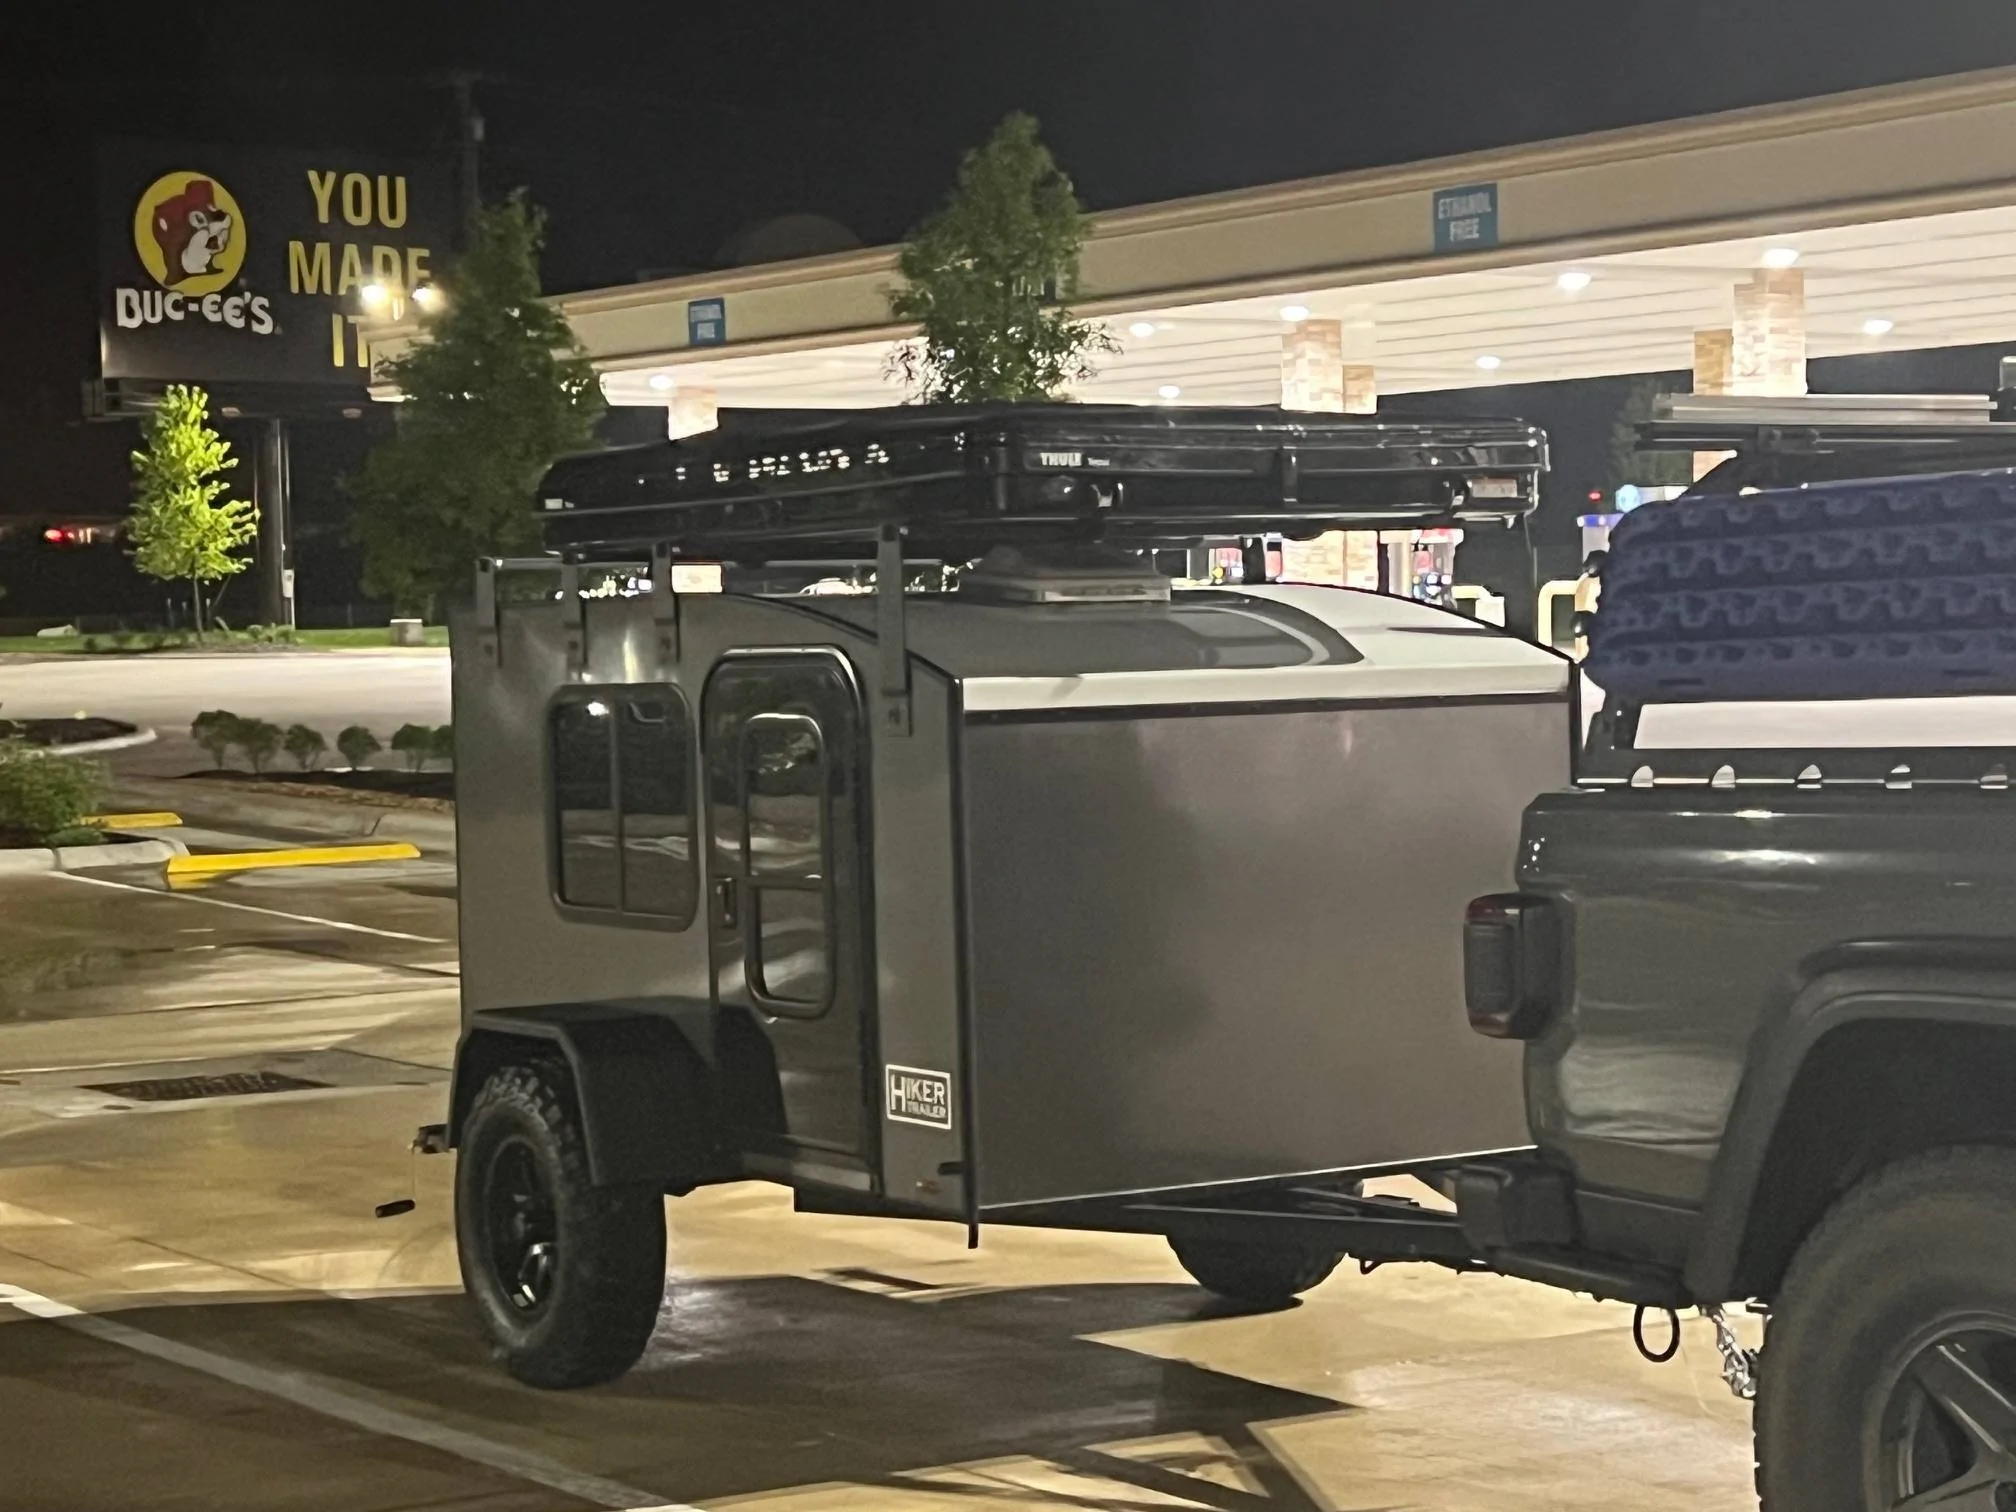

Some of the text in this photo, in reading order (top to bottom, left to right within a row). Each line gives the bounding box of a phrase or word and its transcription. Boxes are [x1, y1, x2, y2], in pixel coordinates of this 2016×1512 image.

[307, 169, 407, 229] YOU
[288, 240, 431, 299] MADE
[890, 1074, 945, 1113] HIKER
